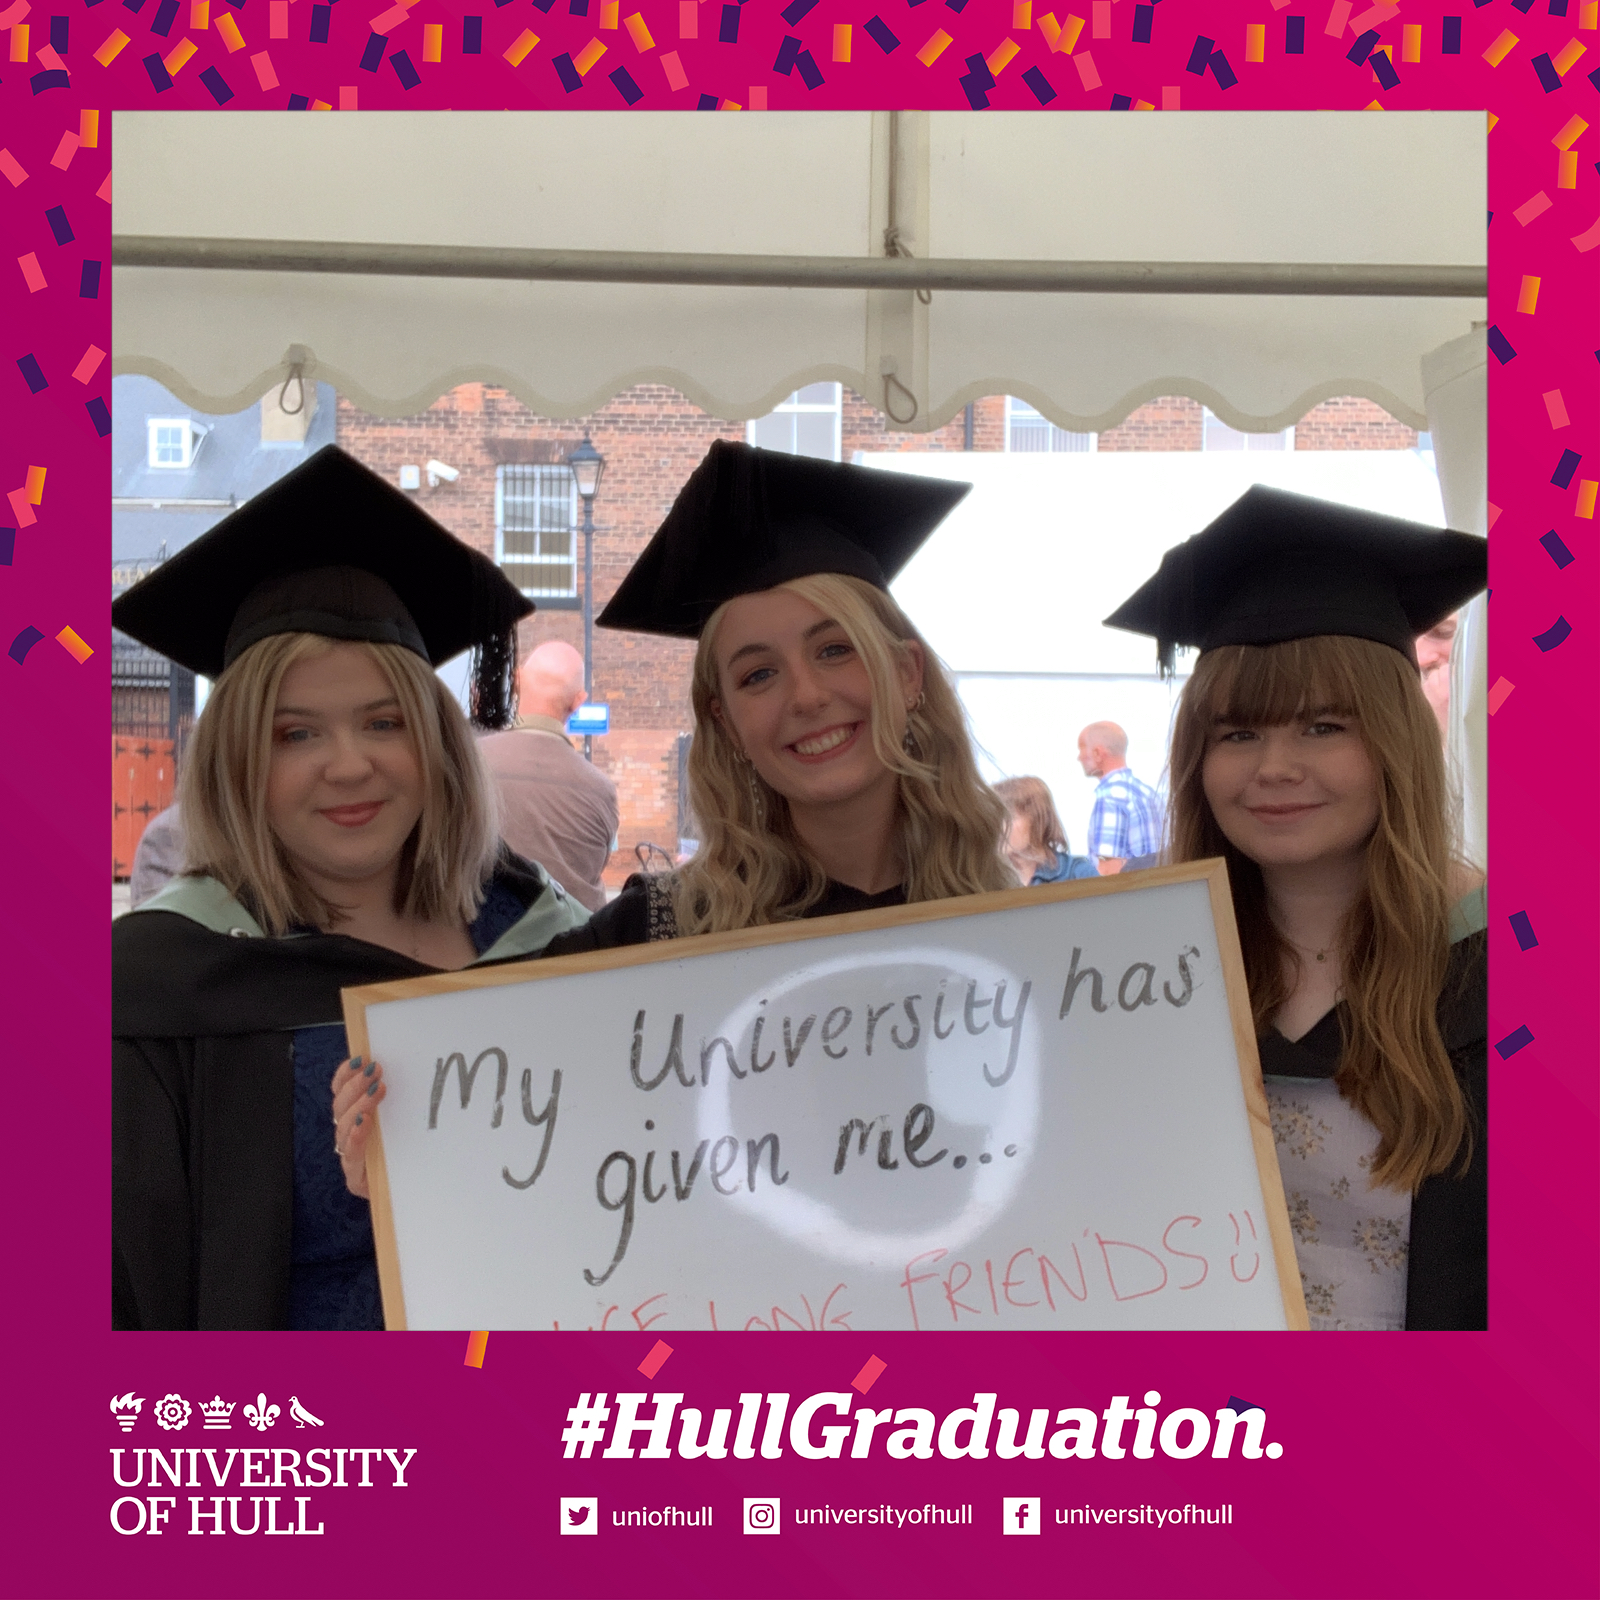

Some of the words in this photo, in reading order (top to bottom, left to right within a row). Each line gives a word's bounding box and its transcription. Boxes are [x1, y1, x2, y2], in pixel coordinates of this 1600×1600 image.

[428, 1046, 563, 1190] My
[630, 977, 1032, 1092] University
[1059, 945, 1202, 1020] has
[583, 1119, 789, 1287] given
[834, 1102, 1018, 1175] me...
[900, 1215, 1208, 1331] FRIENDS
